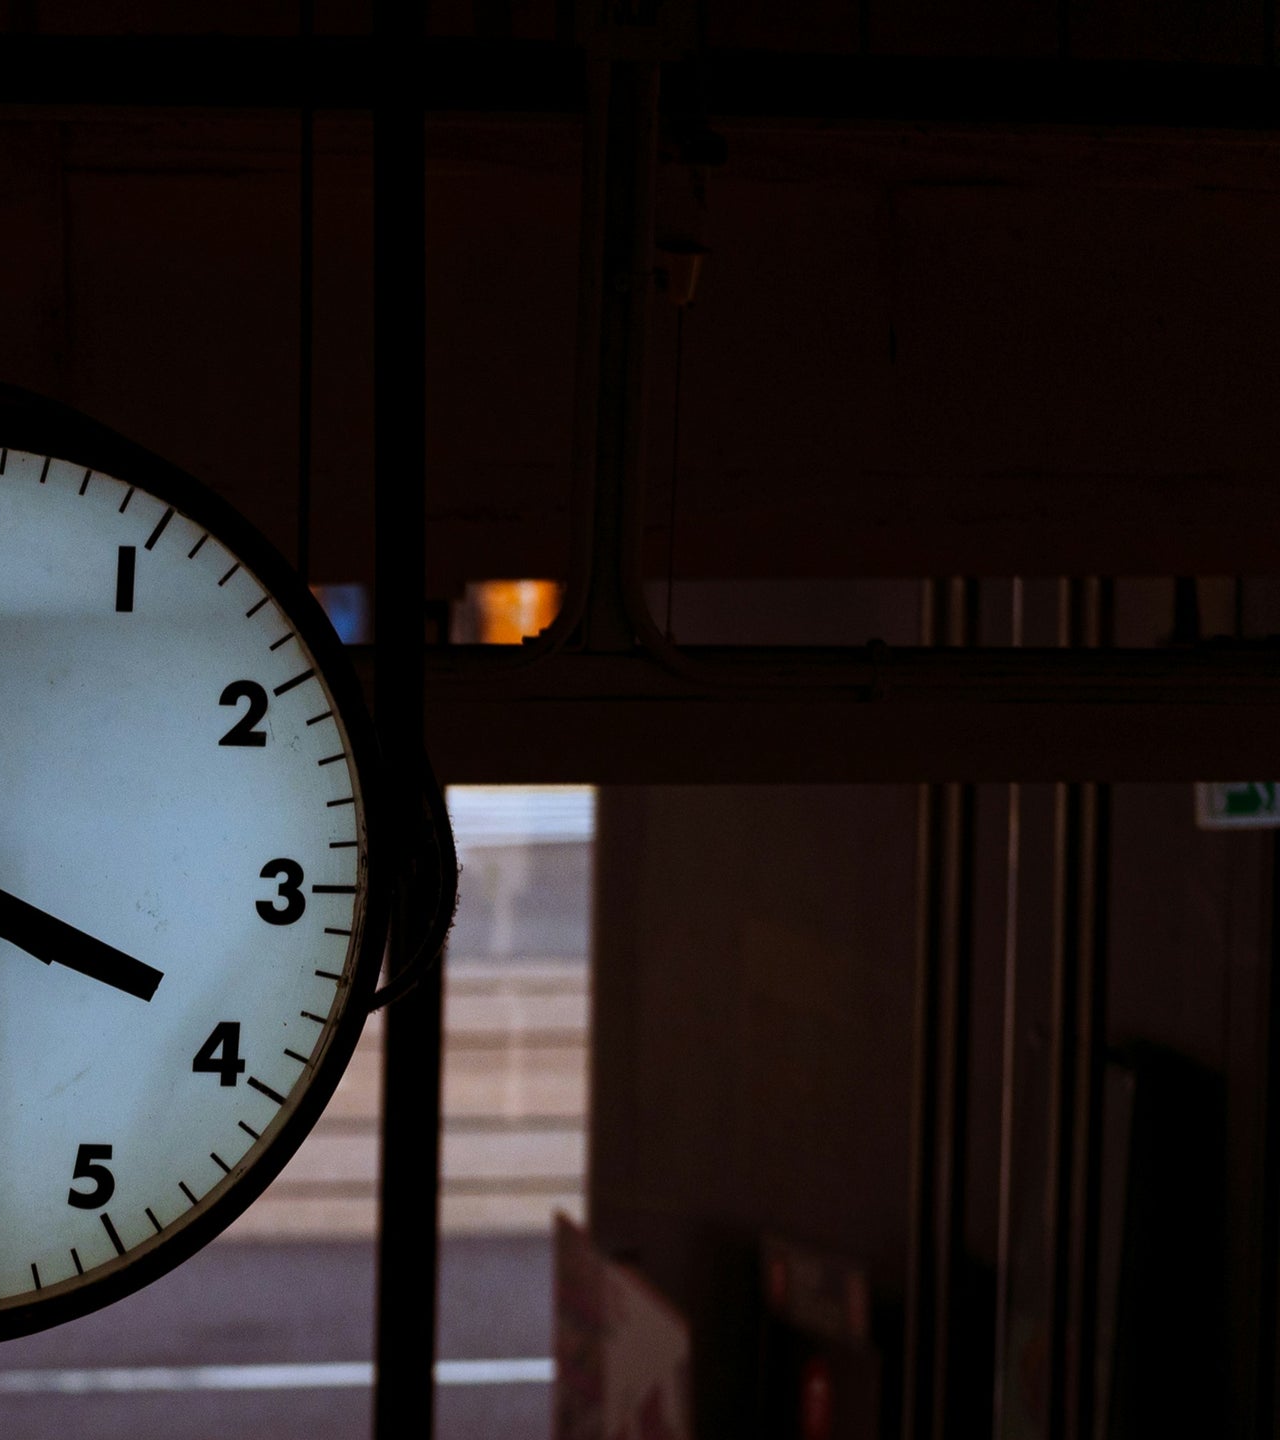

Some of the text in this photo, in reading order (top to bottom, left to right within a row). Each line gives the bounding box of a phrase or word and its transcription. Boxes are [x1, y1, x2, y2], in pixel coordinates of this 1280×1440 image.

[115, 545, 137, 613] 1
[218, 679, 269, 747] 2
[255, 857, 306, 926] 3
[192, 1021, 246, 1087] 4
[67, 1143, 116, 1210] 5
